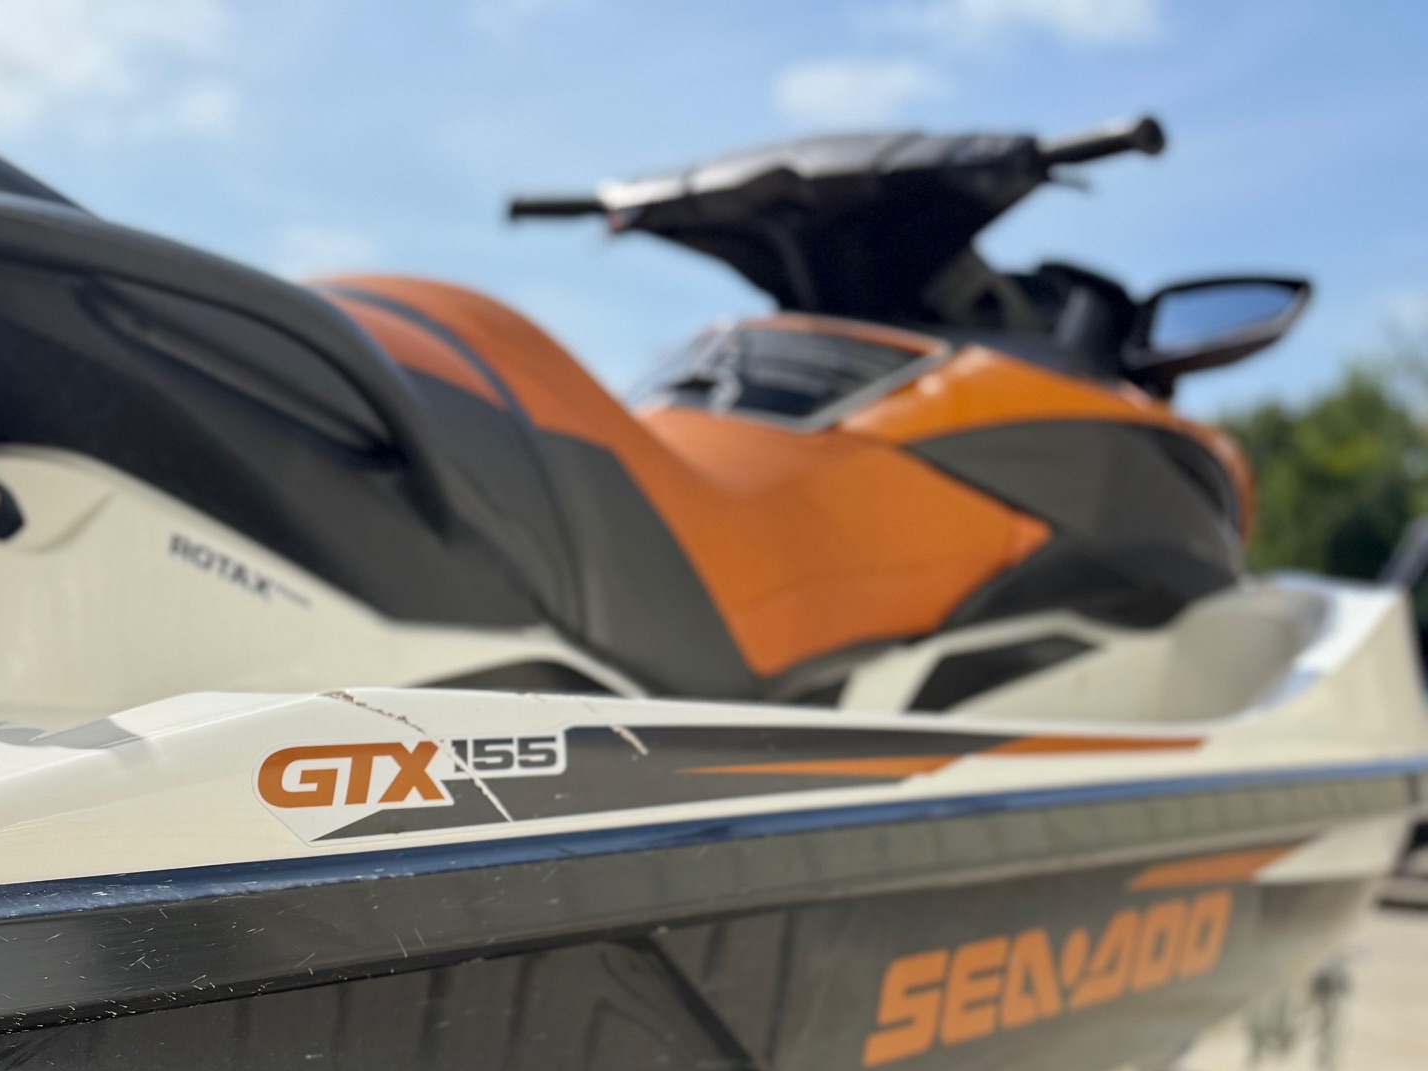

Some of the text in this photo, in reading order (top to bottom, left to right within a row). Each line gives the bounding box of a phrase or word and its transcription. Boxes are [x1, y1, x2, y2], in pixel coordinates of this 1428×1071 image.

[169, 533, 271, 600] ROTAX
[258, 736, 557, 808] GTX 155
